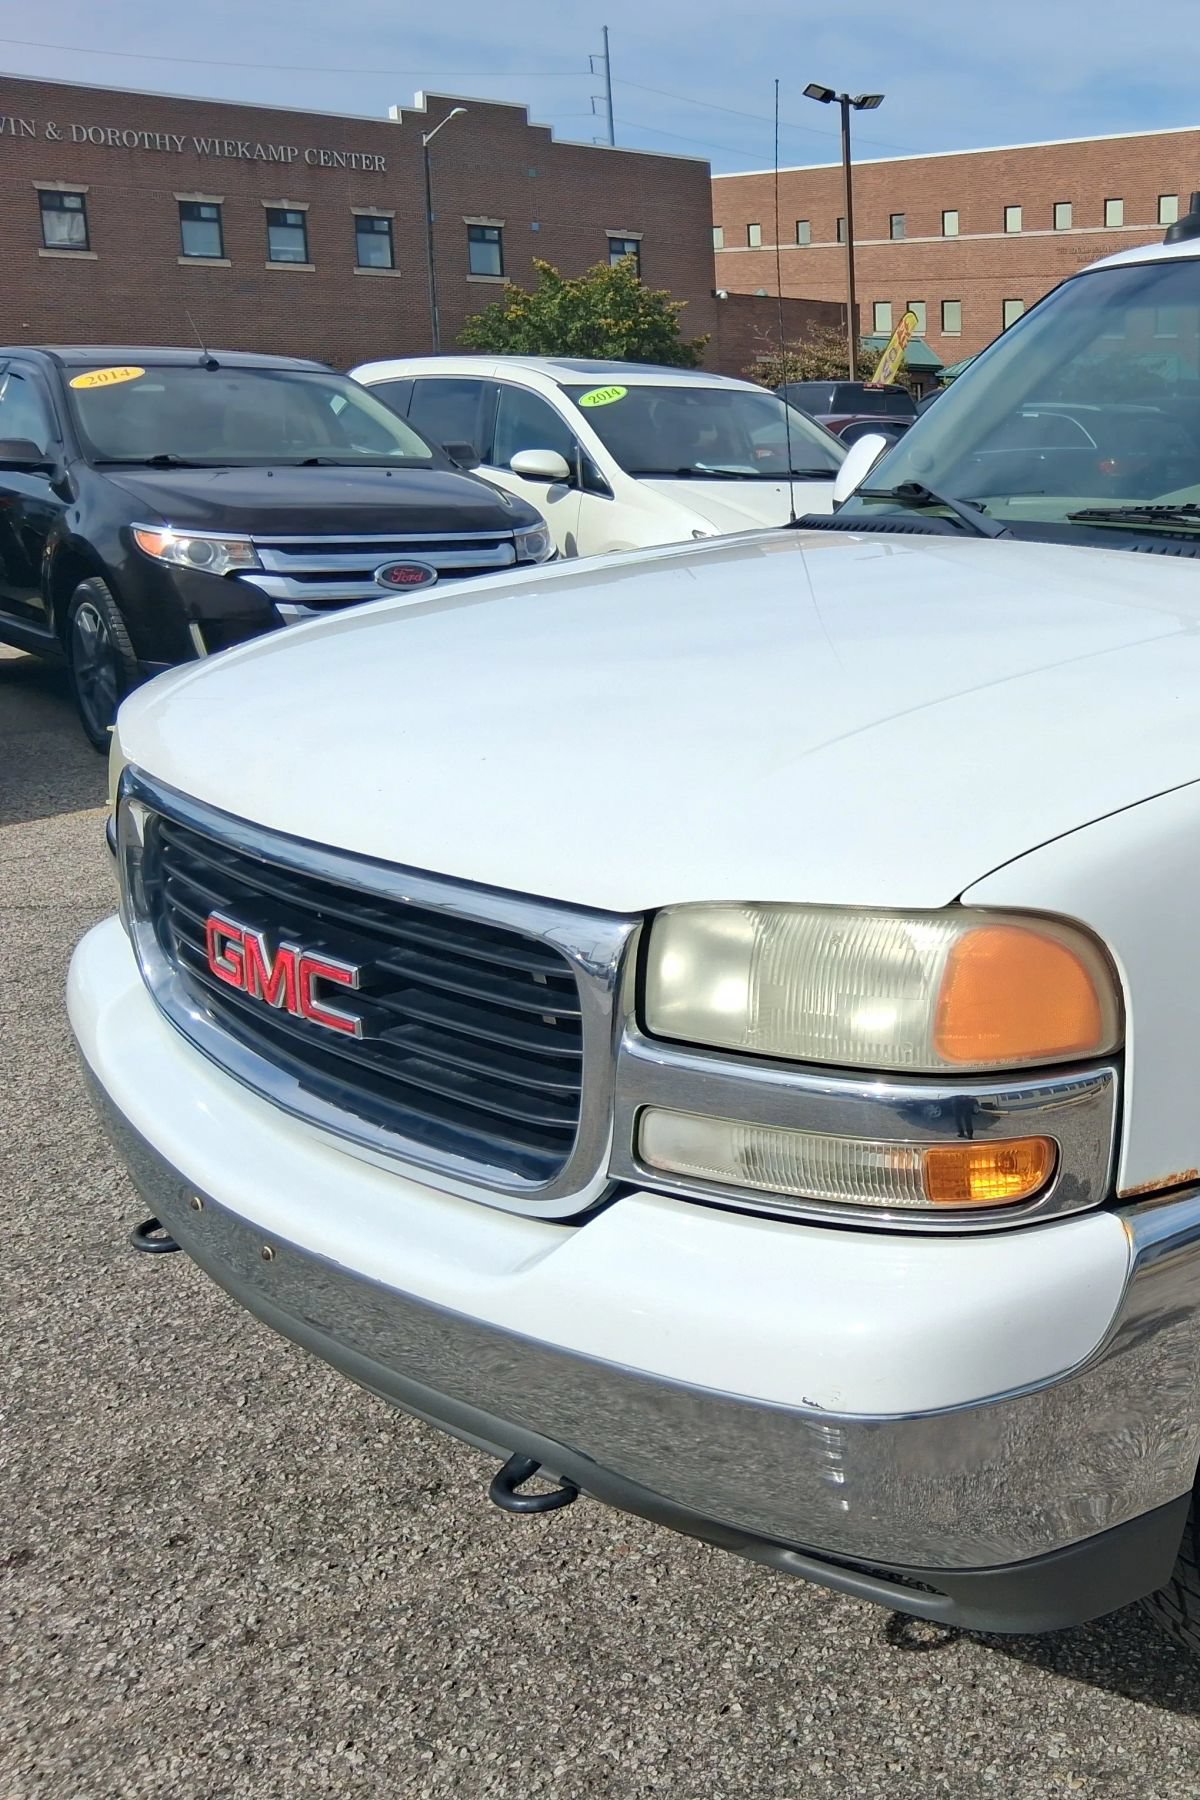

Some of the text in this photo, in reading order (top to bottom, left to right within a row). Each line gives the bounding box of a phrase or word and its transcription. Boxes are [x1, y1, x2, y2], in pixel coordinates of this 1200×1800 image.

[45, 121, 63, 140] &
[71, 124, 186, 153] DOROTHY
[193, 136, 298, 164] WIEKAMP
[304, 148, 387, 172] CENTER
[87, 368, 130, 385] 2014
[588, 387, 621, 404] 2014
[391, 568, 423, 583] Ford
[207, 911, 362, 1040] GMC
